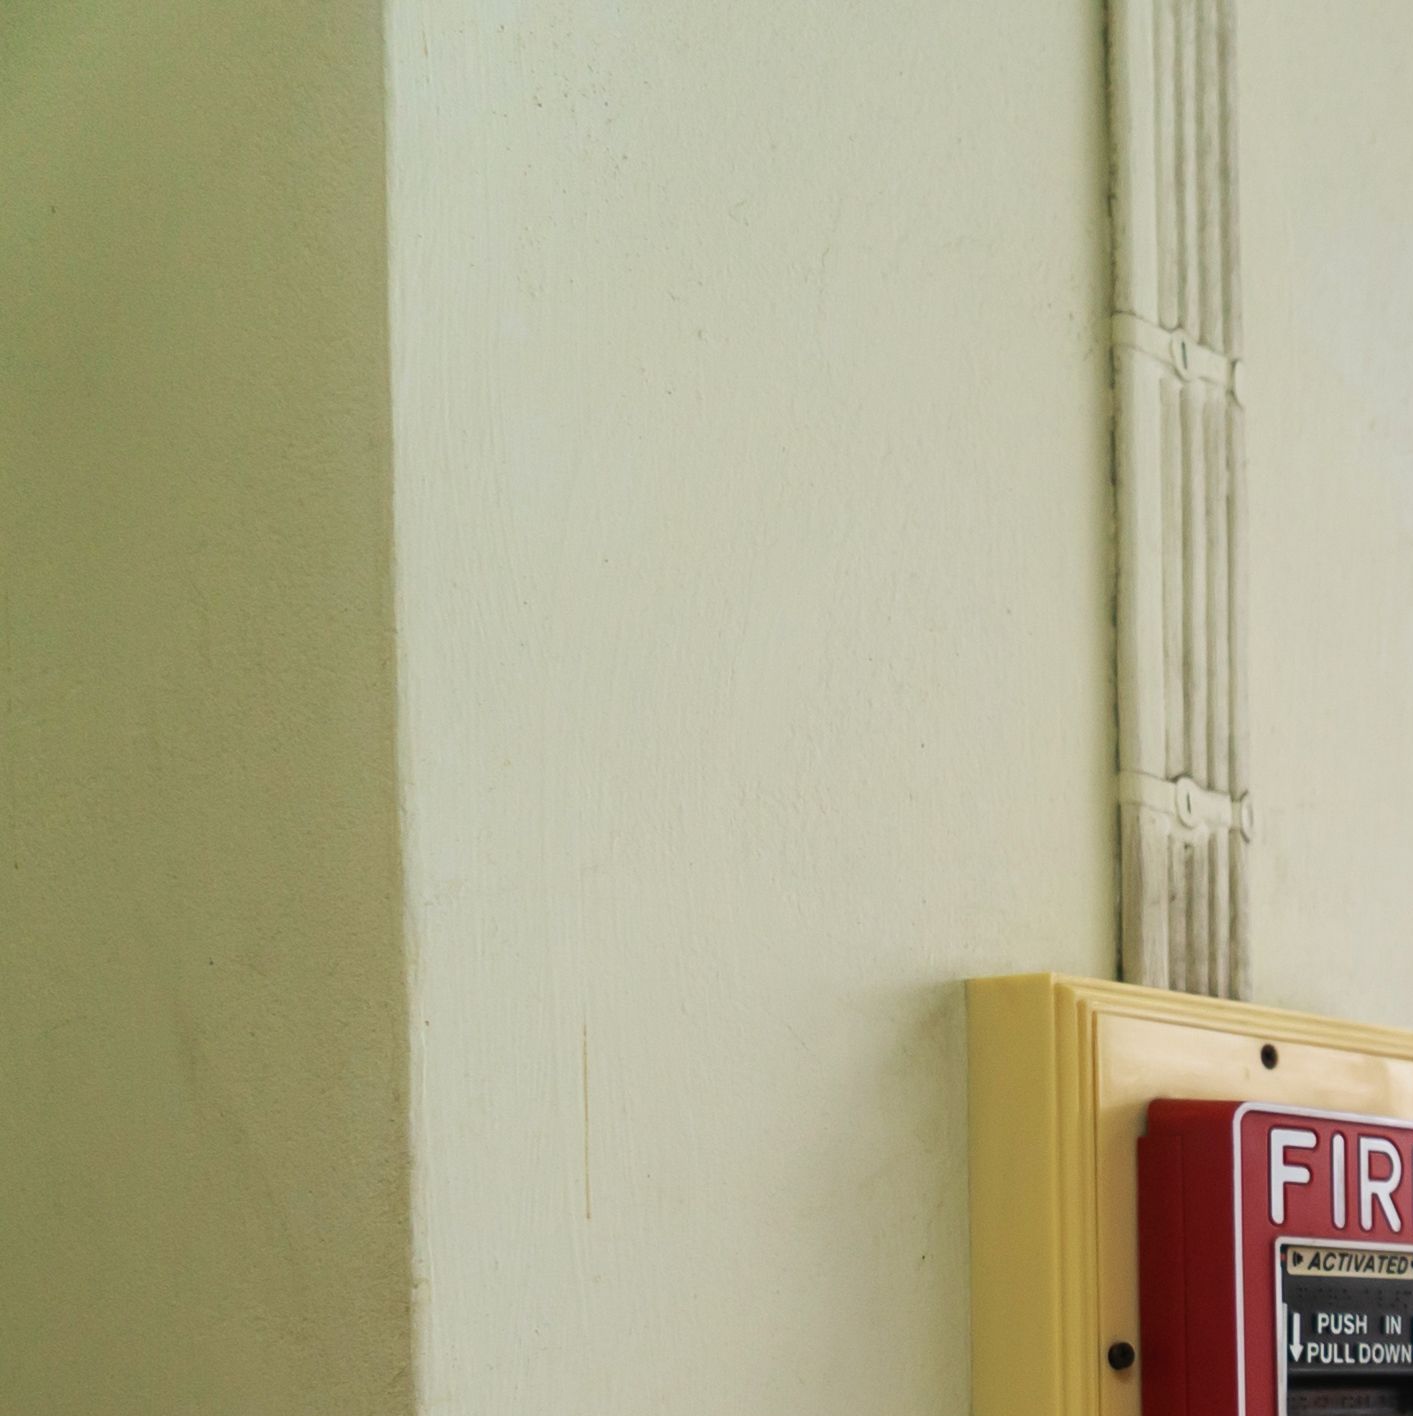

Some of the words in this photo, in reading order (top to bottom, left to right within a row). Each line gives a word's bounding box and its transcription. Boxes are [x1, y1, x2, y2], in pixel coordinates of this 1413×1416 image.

[1308, 1252, 1408, 1274] ACTIVATED
[1317, 1312, 1367, 1334] PUSH
[1385, 1315, 1402, 1334] IN
[1307, 1342, 1355, 1364] PULL
[1359, 1343, 1412, 1364] DOWN
